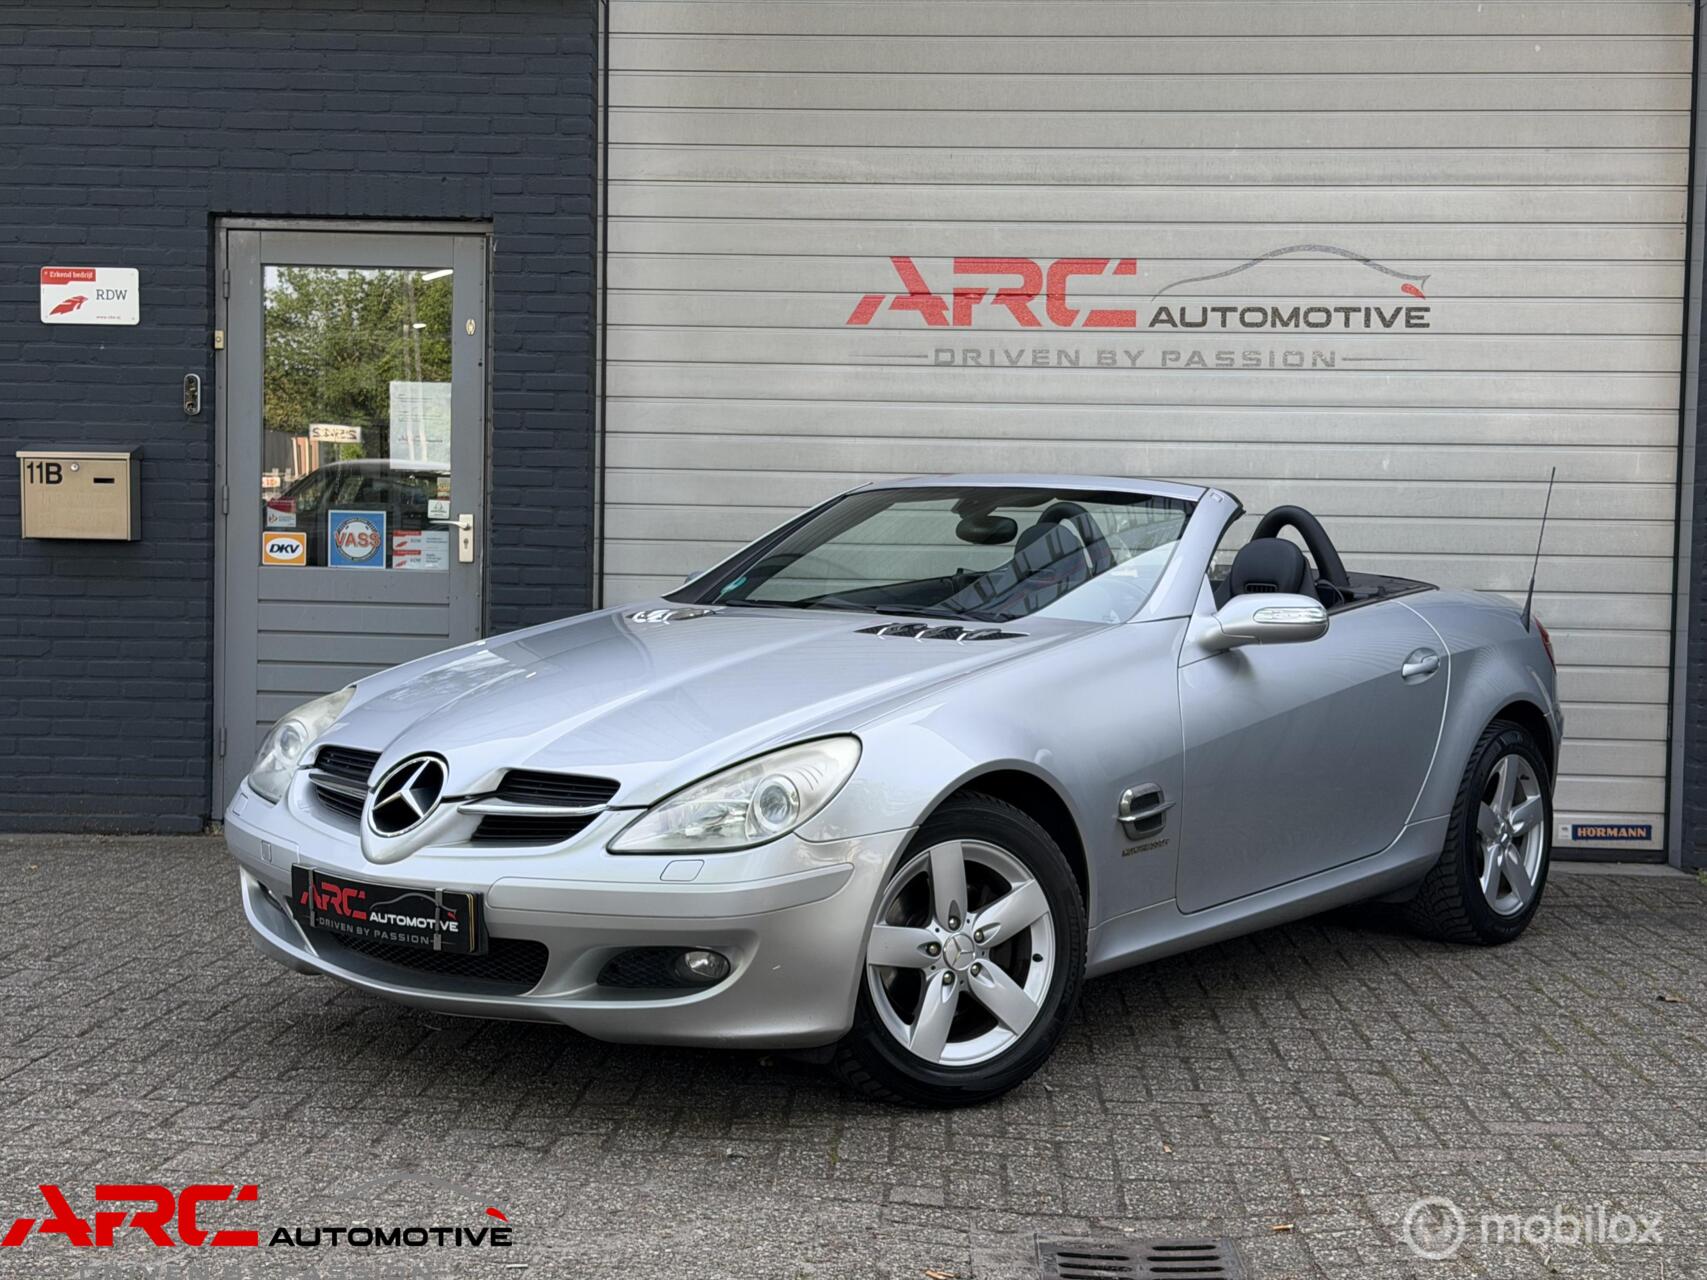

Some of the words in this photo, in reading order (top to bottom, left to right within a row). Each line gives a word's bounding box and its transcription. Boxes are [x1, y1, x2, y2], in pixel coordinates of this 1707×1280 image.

[96, 289, 128, 300] RDW
[846, 256, 1137, 328] ARC
[1148, 306, 1431, 329] AUTOMOTIVE
[934, 348, 1081, 368] DRIVEN
[1097, 348, 1146, 368] BY
[1162, 349, 1337, 368] PASSION
[26, 461, 62, 485] 11B
[269, 543, 300, 554] DKV
[335, 531, 381, 548] VASS
[300, 881, 366, 919] ARC
[369, 912, 458, 931] AUTOMOTVE
[318, 917, 355, 934] DRIVEN
[355, 925, 371, 937] BY
[373, 930, 430, 945] PASSION
